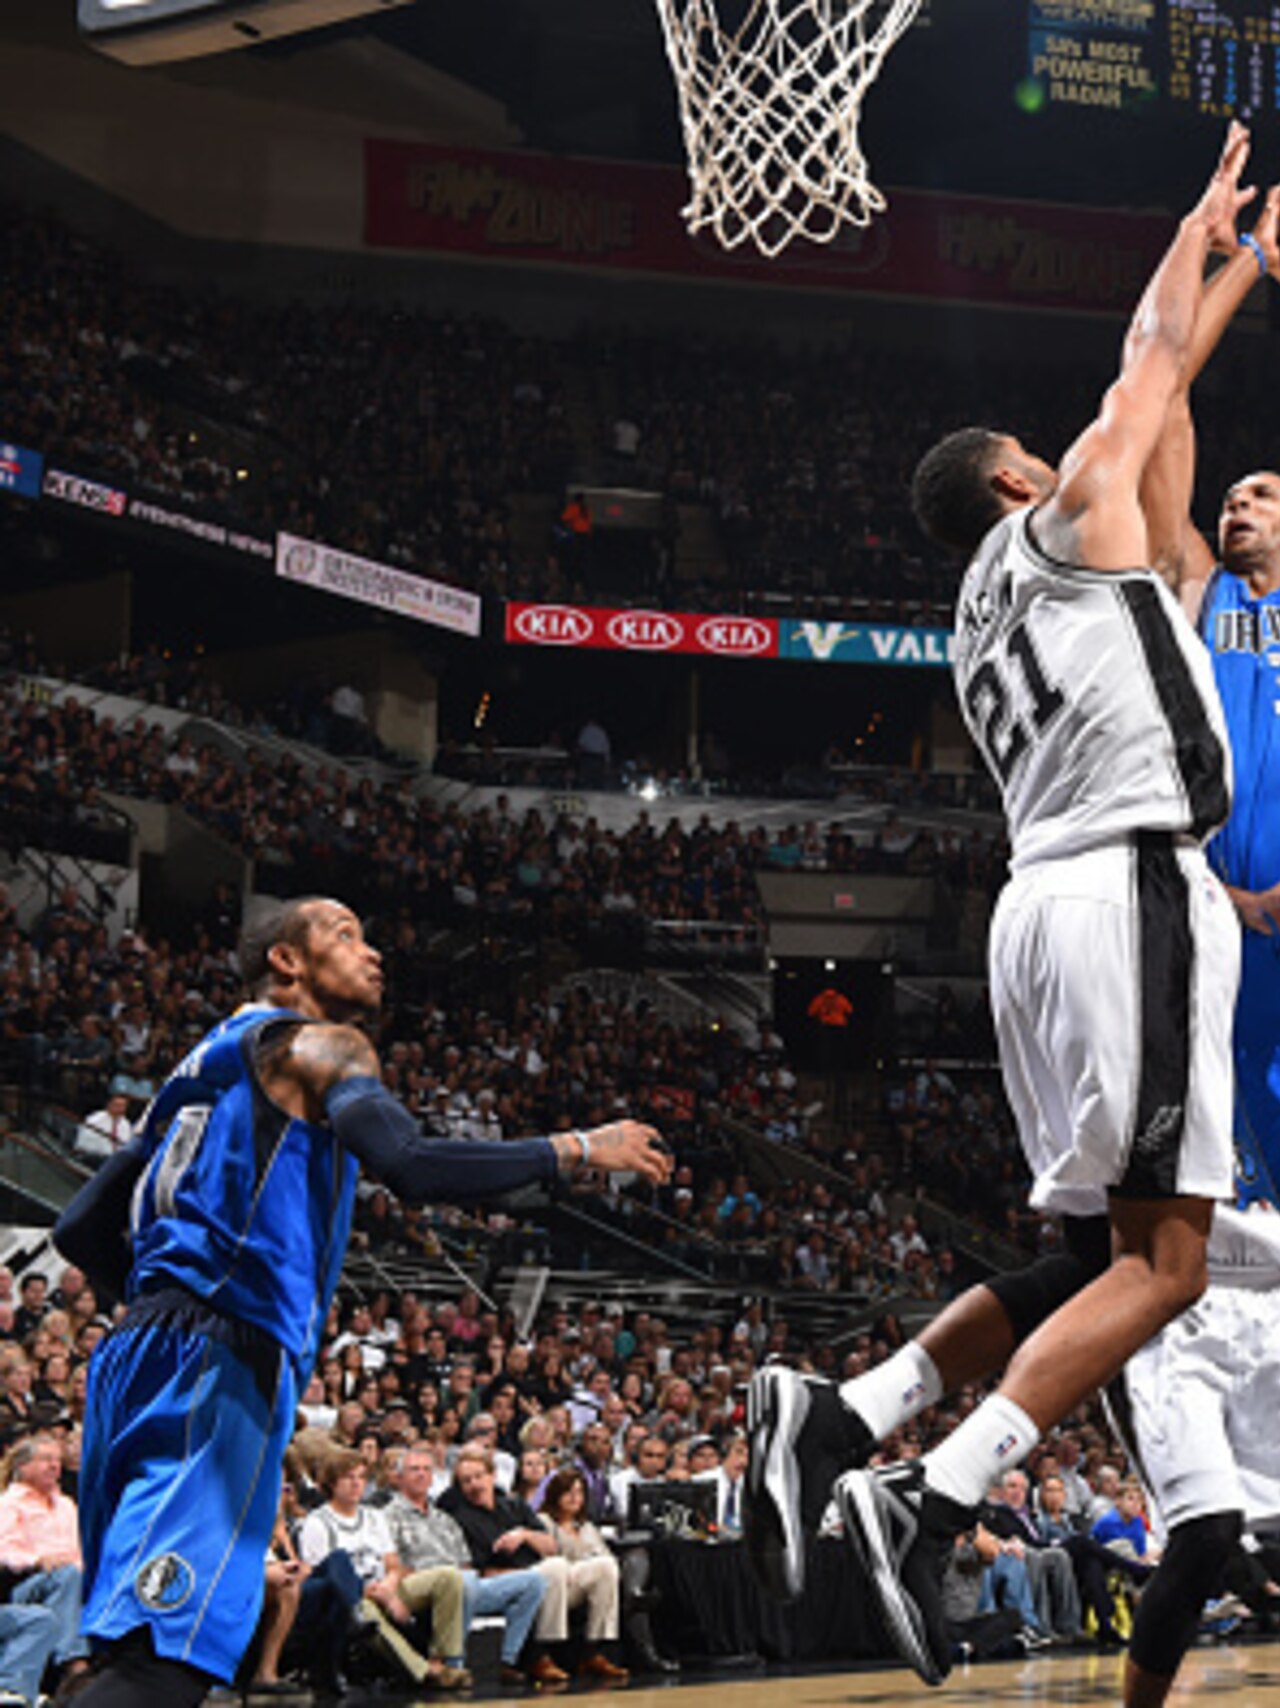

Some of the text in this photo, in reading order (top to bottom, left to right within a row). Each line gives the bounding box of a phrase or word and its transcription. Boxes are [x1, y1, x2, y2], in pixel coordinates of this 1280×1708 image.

[1033, 54, 1157, 93] POWERFUL
[526, 611, 581, 636] KIA
[618, 616, 672, 642] KIA
[709, 623, 763, 647] KIA
[964, 620, 1066, 781] 21
